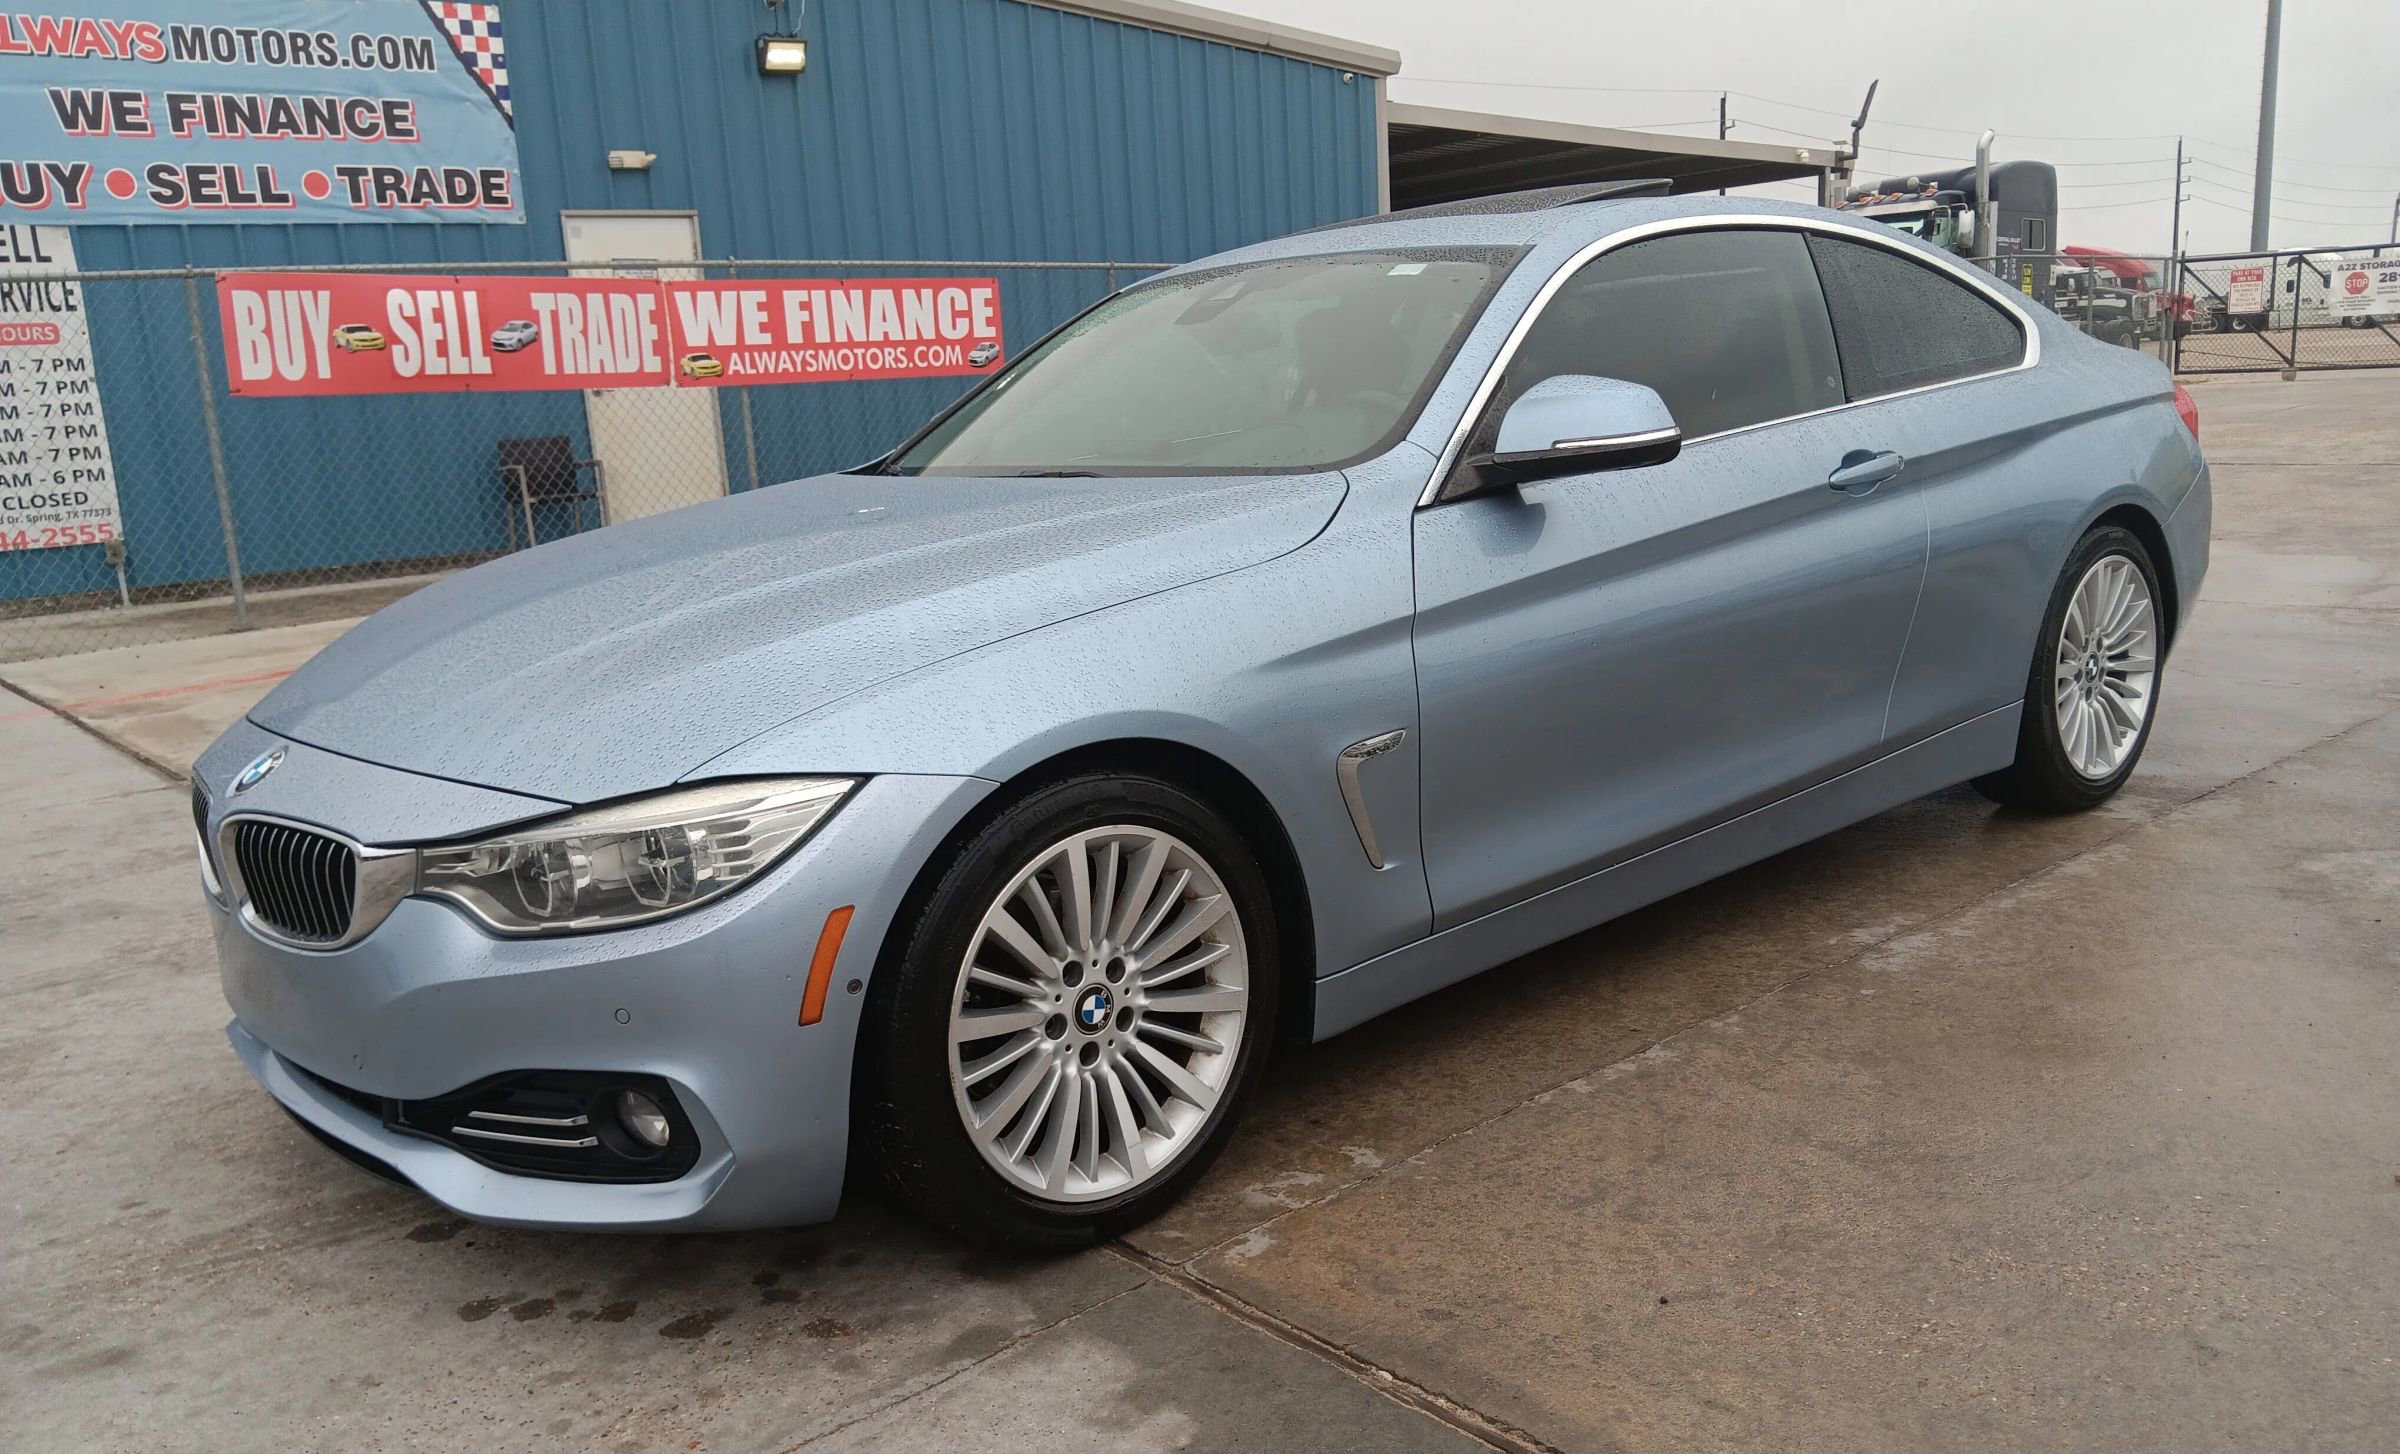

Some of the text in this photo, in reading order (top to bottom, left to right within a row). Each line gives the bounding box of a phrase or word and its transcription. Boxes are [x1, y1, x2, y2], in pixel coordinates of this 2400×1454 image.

[46, 88, 418, 140] WE FINANCE
[0, 160, 512, 209] UY SELL TRADE
[2337, 263, 2358, 271] A2Z
[2346, 279, 2368, 289] STOP
[673, 287, 996, 347] WE FINANCE
[2, 326, 55, 342] OURS
[232, 288, 662, 381] BUY SELL TRADE
[31, 358, 43, 373] 7
[52, 358, 85, 372] PM
[728, 345, 963, 375] ALWAYSMOTORS.COM
[35, 381, 47, 395] 7
[56, 380, 89, 395] PM
[40, 404, 52, 418] 7
[60, 402, 94, 417] PM
[44, 426, 56, 440] 7
[64, 424, 98, 439] PM
[48, 448, 60, 463] 7
[68, 446, 102, 461] PM
[53, 471, 66, 485] 6
[72, 468, 106, 483] PM
[3, 491, 88, 510] CLOSED
[66, 510, 79, 520] TX
